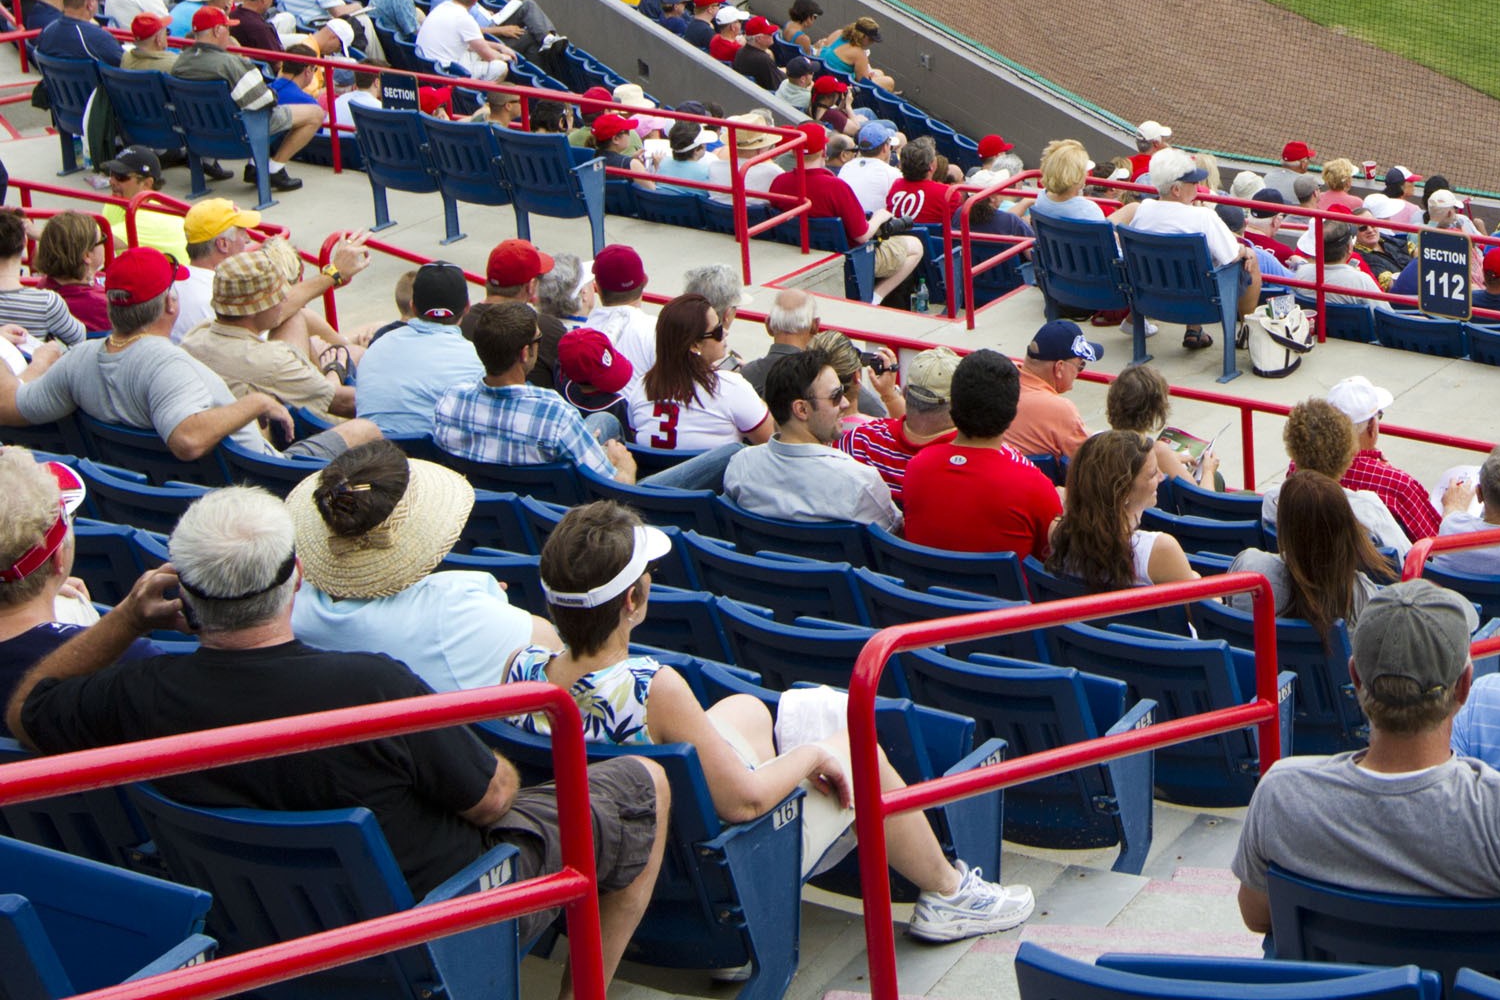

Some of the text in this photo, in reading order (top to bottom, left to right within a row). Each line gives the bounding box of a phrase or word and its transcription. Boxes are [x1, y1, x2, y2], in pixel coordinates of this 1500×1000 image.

[384, 87, 415, 101] SECTION
[1424, 248, 1466, 265] SECTION
[1425, 270, 1465, 301] 112
[650, 402, 680, 450] 3
[778, 800, 794, 828] 16
[487, 863, 505, 889] 17
